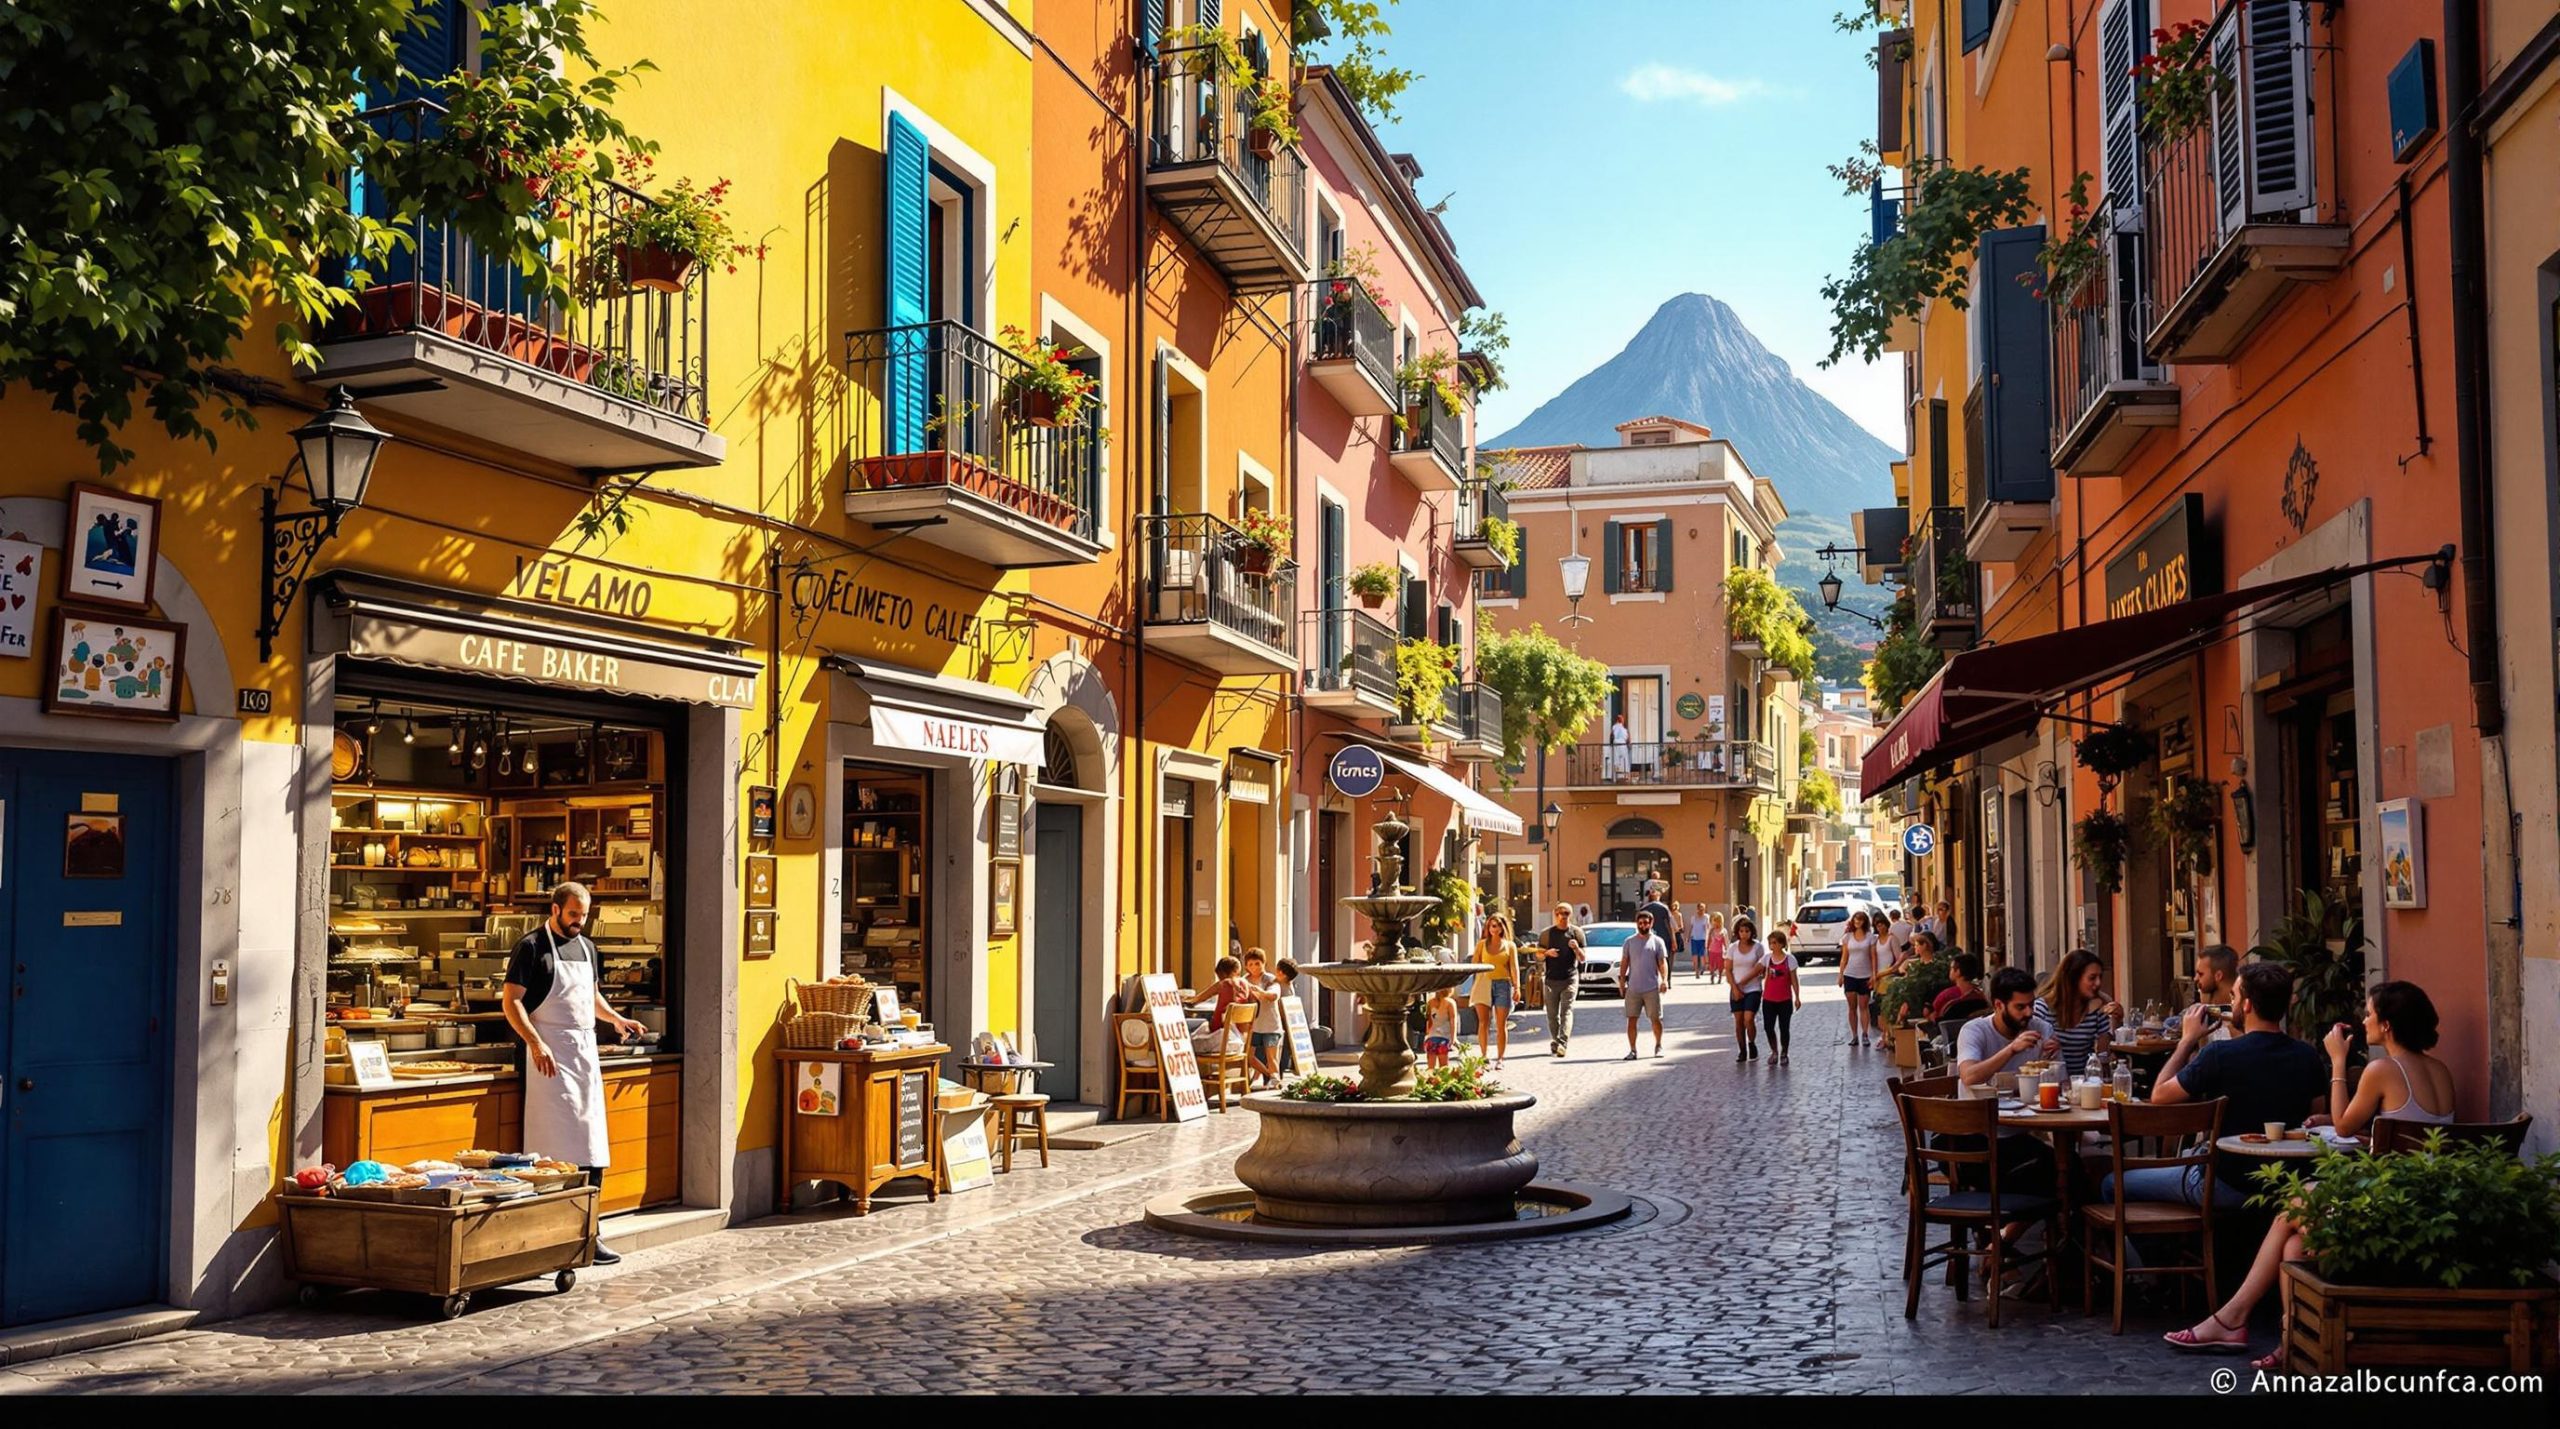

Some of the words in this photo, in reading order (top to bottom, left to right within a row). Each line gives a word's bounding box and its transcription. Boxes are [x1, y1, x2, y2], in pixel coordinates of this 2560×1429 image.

[516, 556, 651, 618] VELAMO
[459, 634, 528, 673] CAFE
[542, 647, 619, 687] BAKER
[923, 720, 989, 754] NAELES
